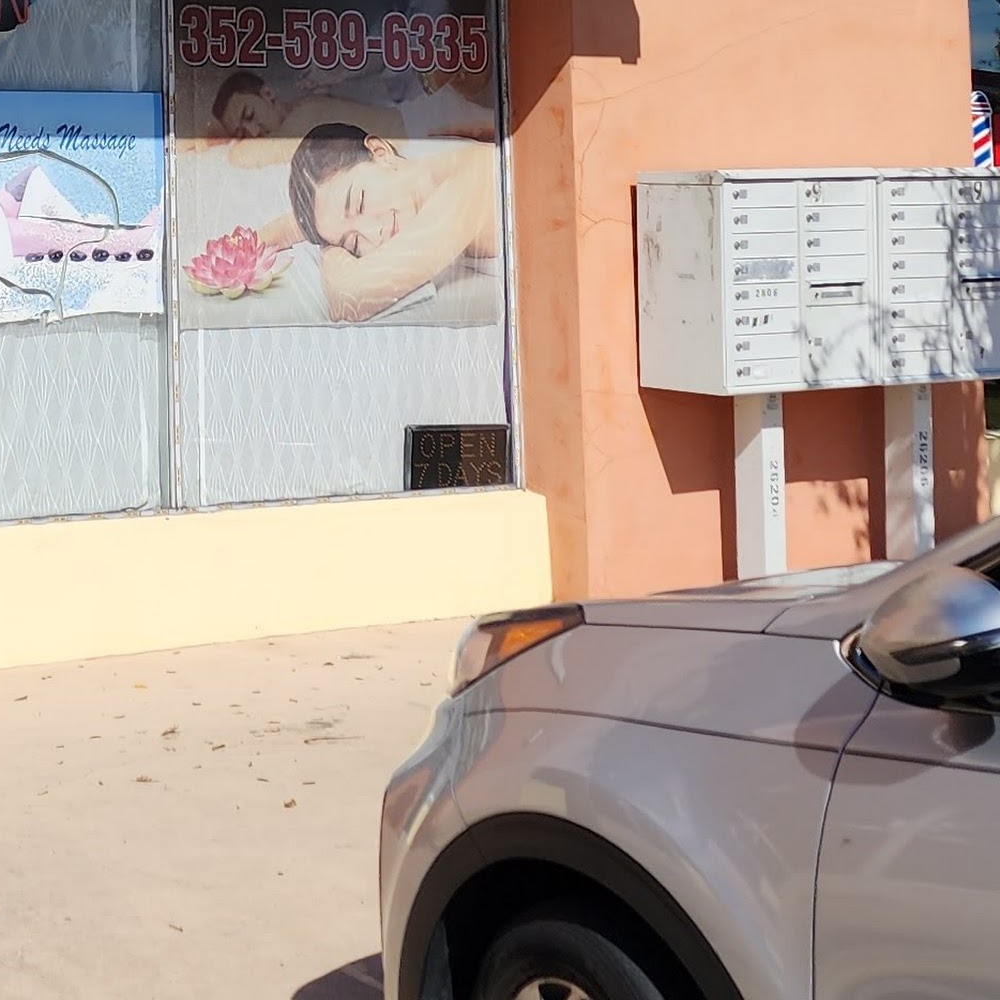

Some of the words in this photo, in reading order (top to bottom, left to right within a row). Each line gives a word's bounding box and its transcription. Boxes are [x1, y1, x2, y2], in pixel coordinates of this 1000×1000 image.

[179, 4, 489, 73] 352-589-6335
[56, 123, 137, 159] Massage
[973, 181, 983, 201] 9
[420, 432, 496, 459] OPEN
[414, 461, 430, 489] 7
[437, 460, 503, 488] DAYS
